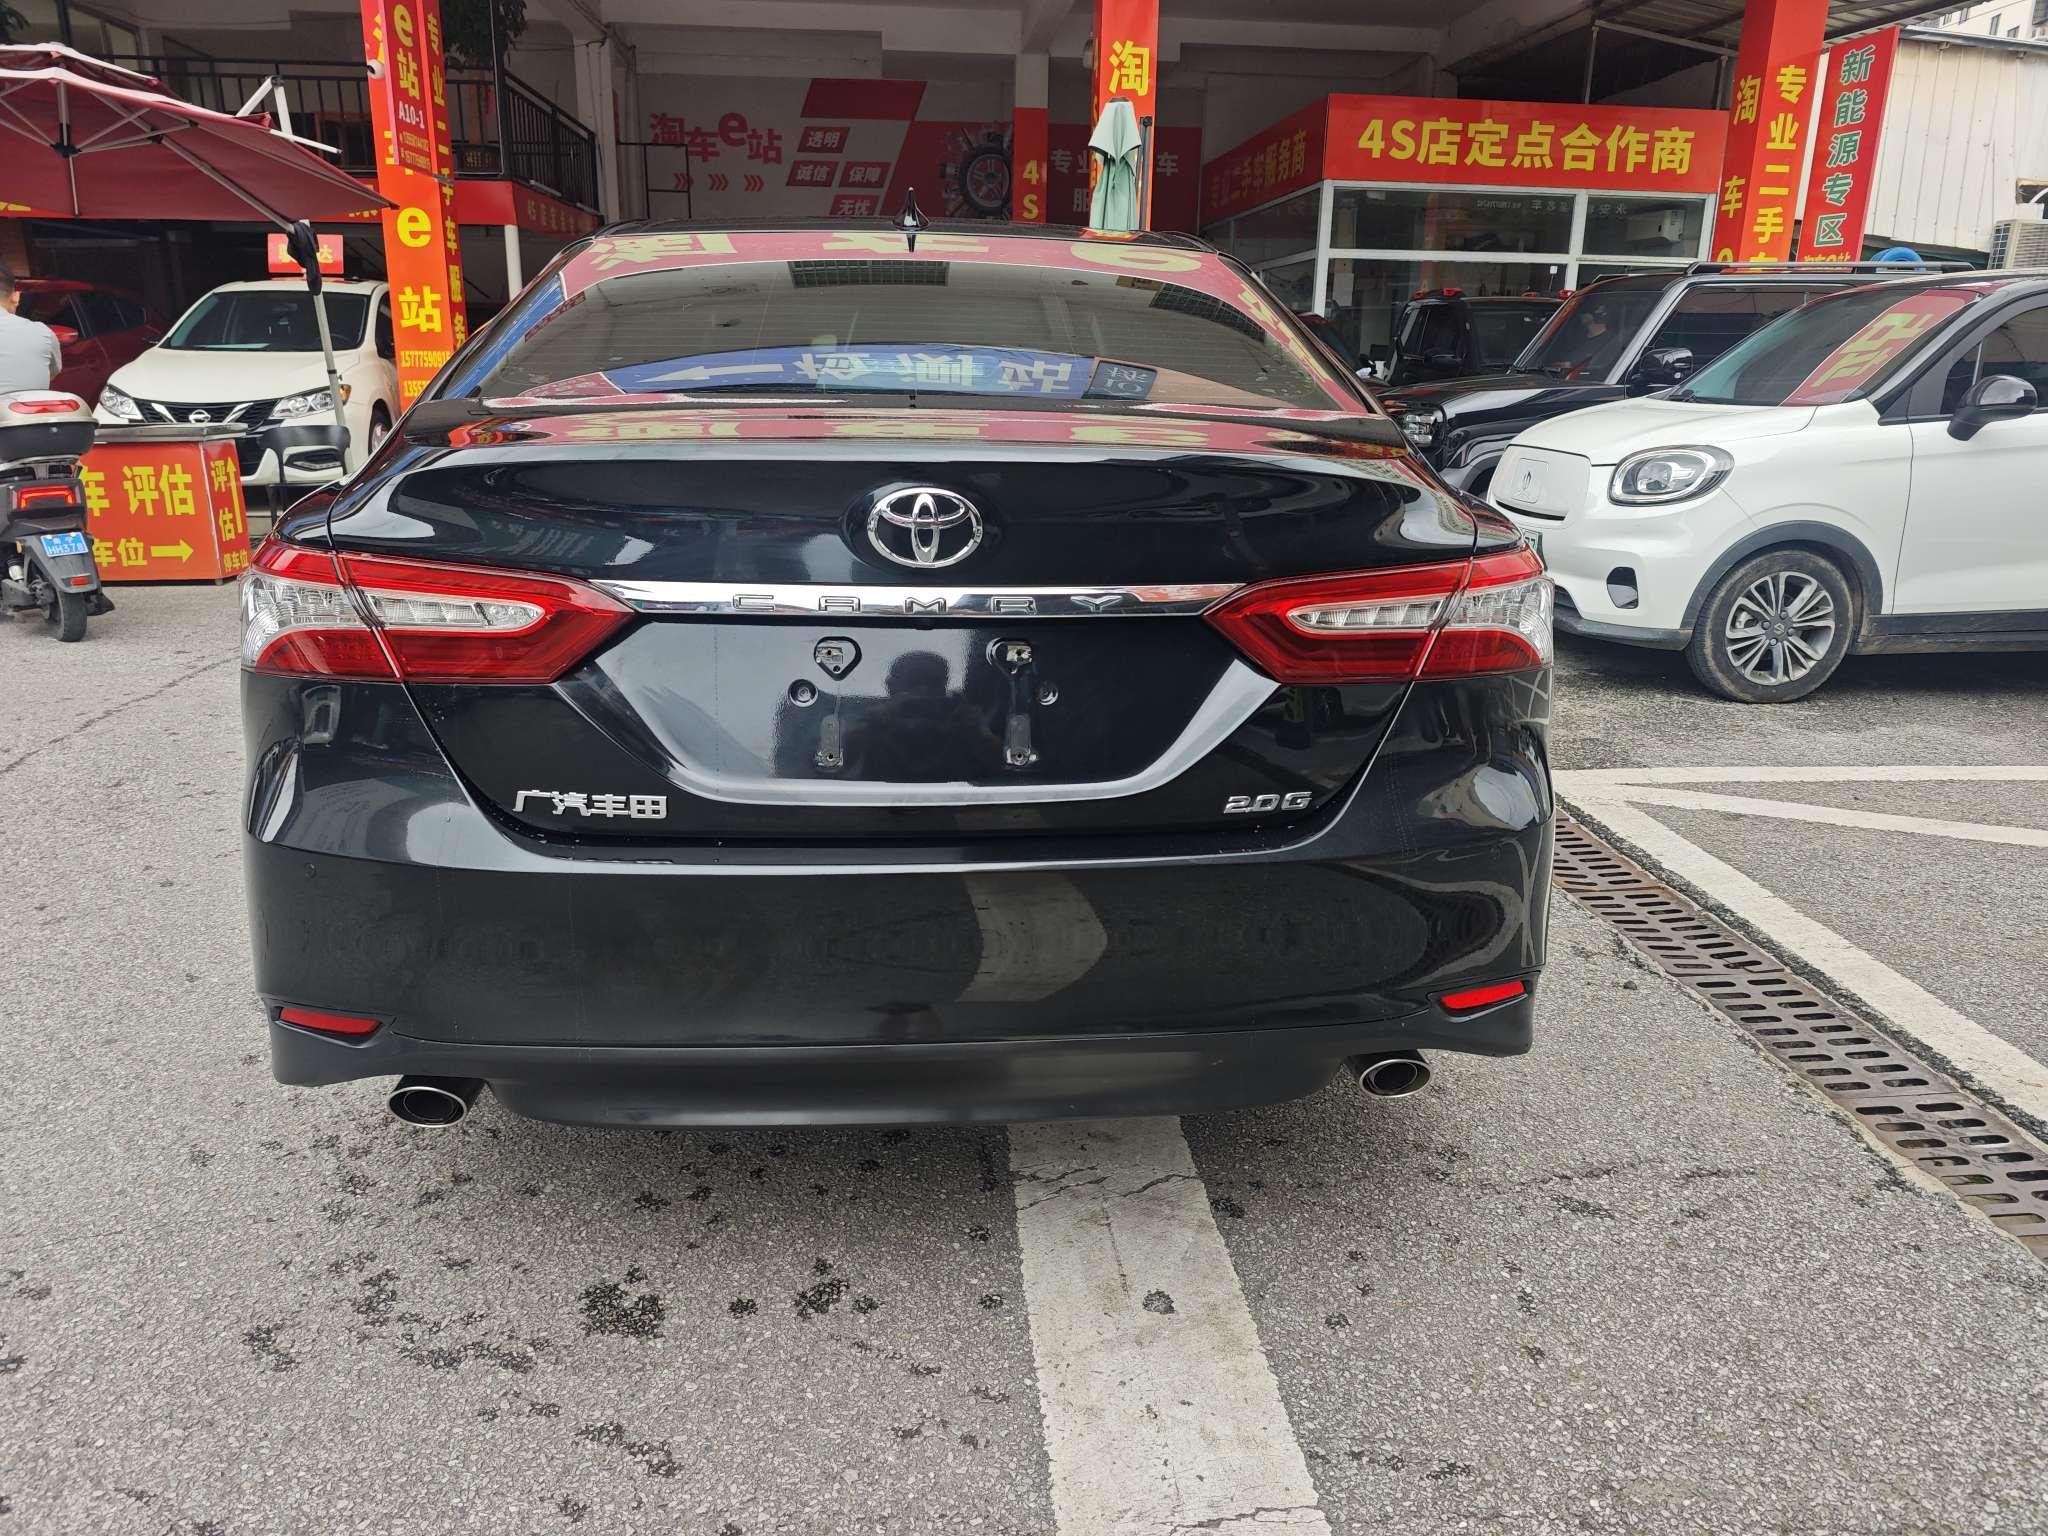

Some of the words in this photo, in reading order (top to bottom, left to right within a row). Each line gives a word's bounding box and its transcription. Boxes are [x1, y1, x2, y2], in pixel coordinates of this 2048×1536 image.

[1108, 40, 1150, 97] 淘
[399, 100, 426, 129] A10-1
[649, 112, 783, 165] 淘车e站
[806, 131, 841, 148] 透明
[1357, 117, 1697, 176] 4S店定点合作商
[1750, 64, 1808, 263] 专业二手
[1813, 44, 1877, 248] 新能源专区
[848, 166, 882, 183] 保障
[1022, 159, 1041, 220] 4S
[732, 593, 1122, 615] CAMRY
[512, 789, 668, 820] 广汽丰田
